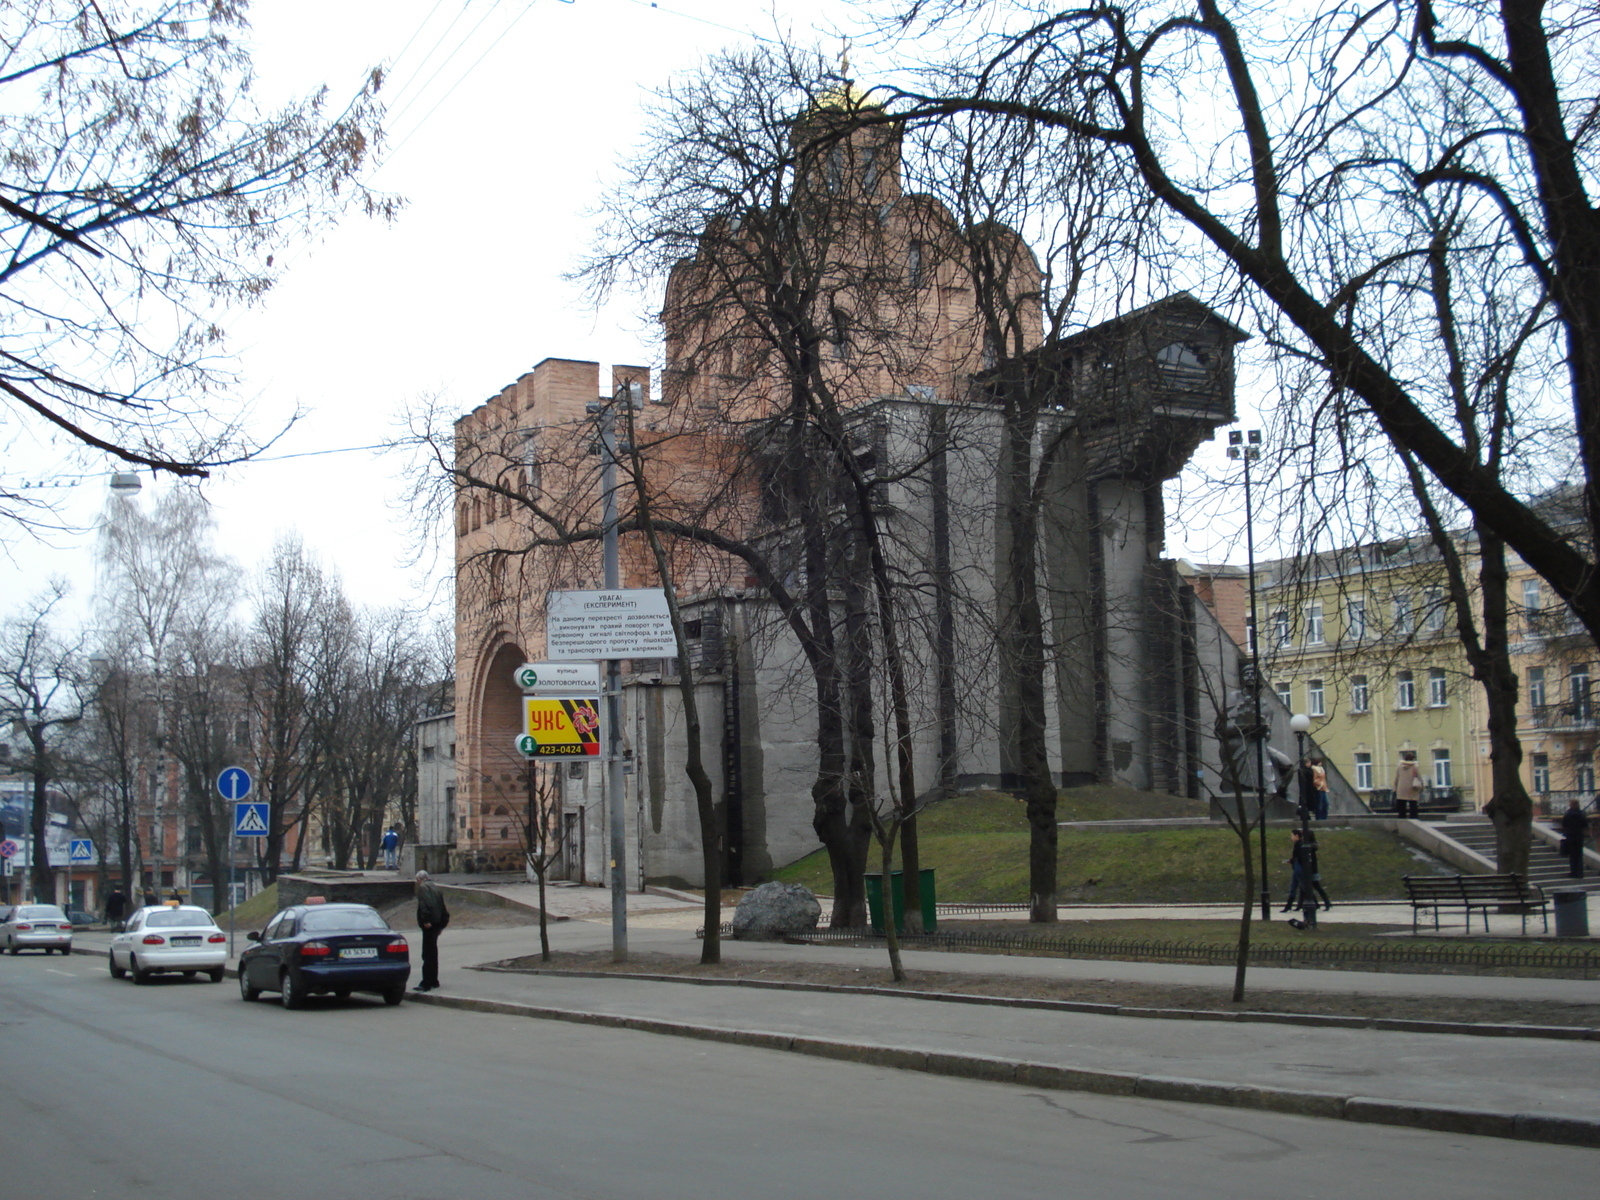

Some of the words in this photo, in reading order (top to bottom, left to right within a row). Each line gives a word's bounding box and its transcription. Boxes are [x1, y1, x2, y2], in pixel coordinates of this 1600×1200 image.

[615, 630, 651, 638] світлофора,
[532, 710, 565, 731] УКС
[540, 746, 581, 754] 423-0424
